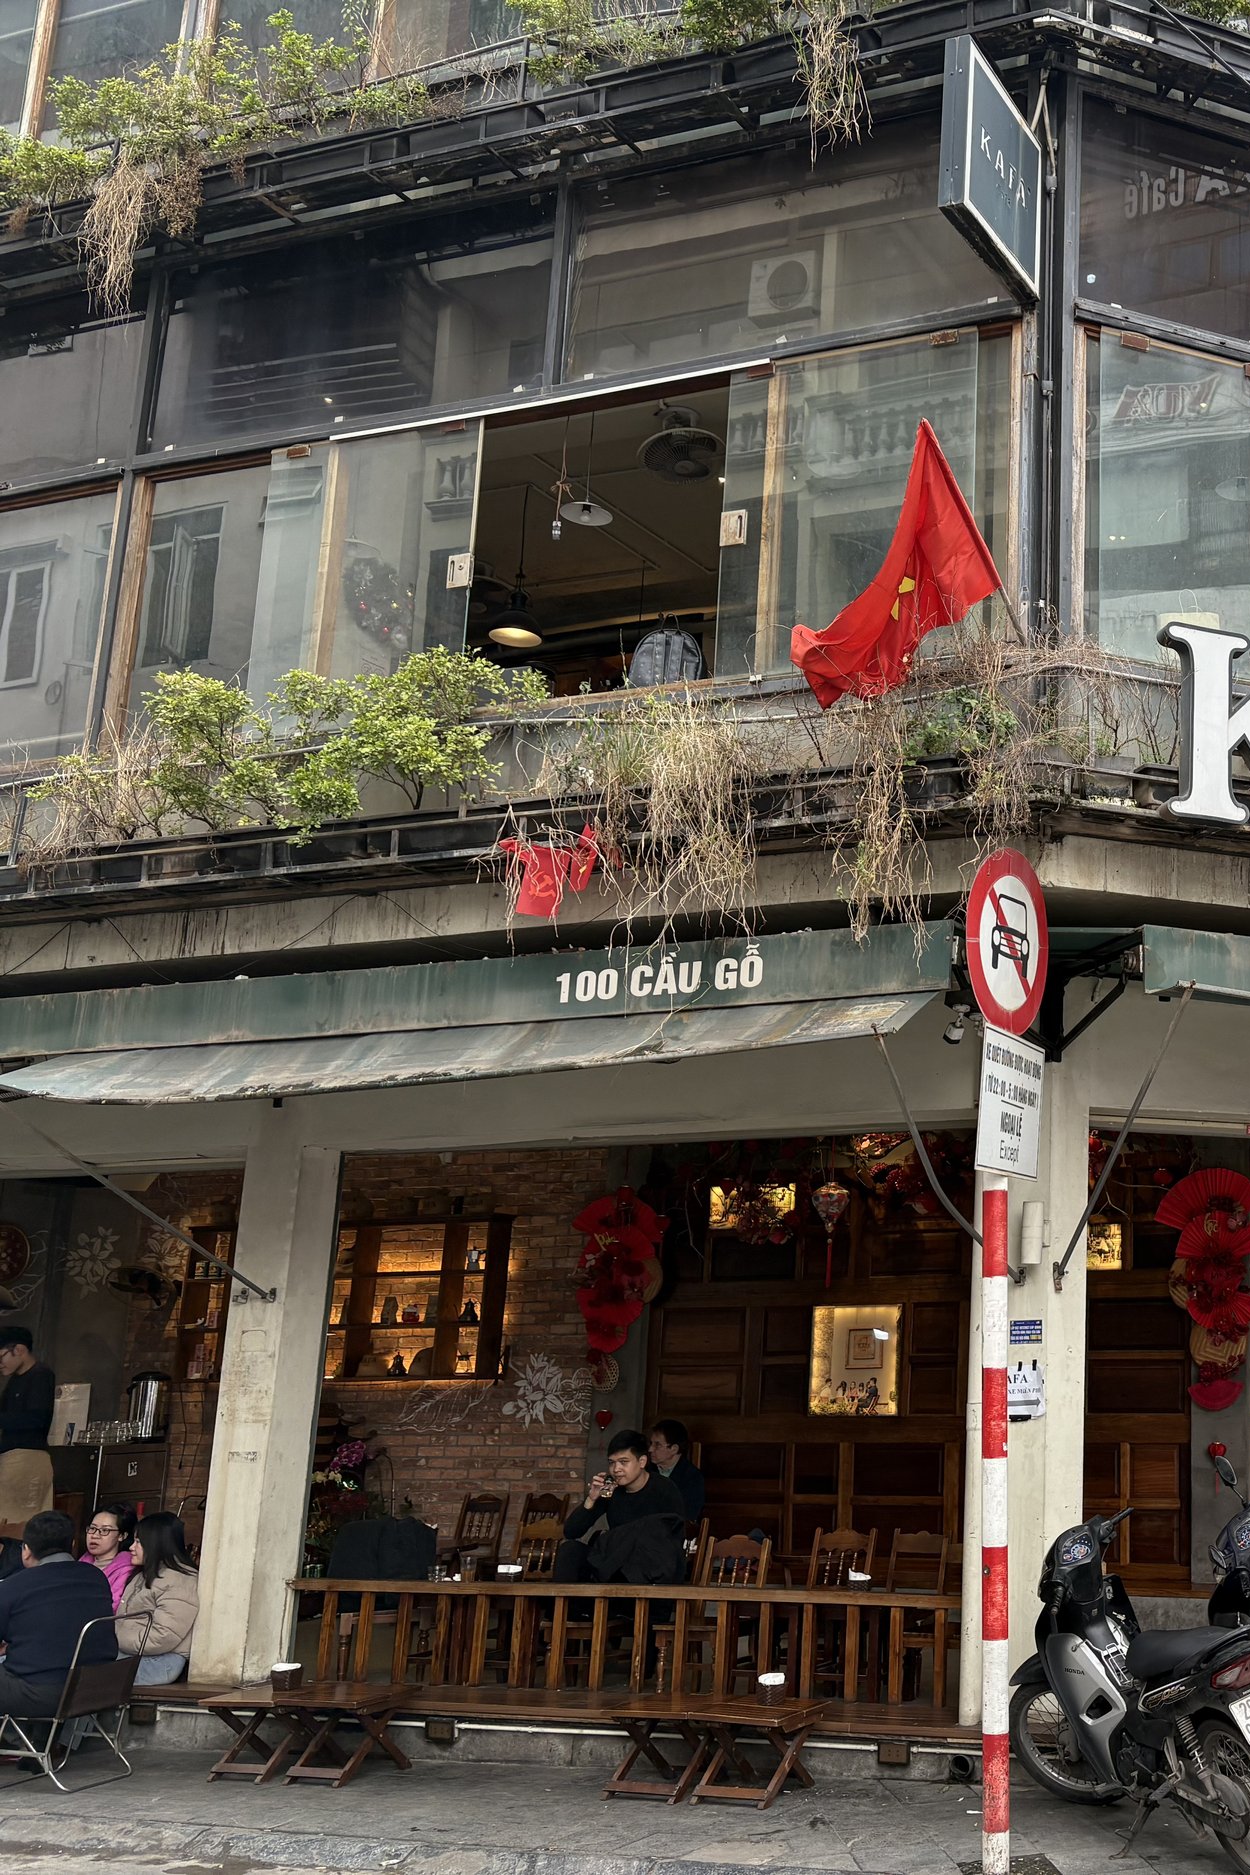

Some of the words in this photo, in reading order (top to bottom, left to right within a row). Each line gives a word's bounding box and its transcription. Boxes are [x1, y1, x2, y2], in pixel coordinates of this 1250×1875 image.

[980, 124, 1026, 208] KAFA
[556, 968, 618, 1003] 100
[630, 952, 702, 997] CẦU
[714, 944, 764, 990] GỖ
[1000, 1140, 1019, 1166] Except
[1007, 1374, 1028, 1384] FA
[1064, 1667, 1085, 1676] HONDA
